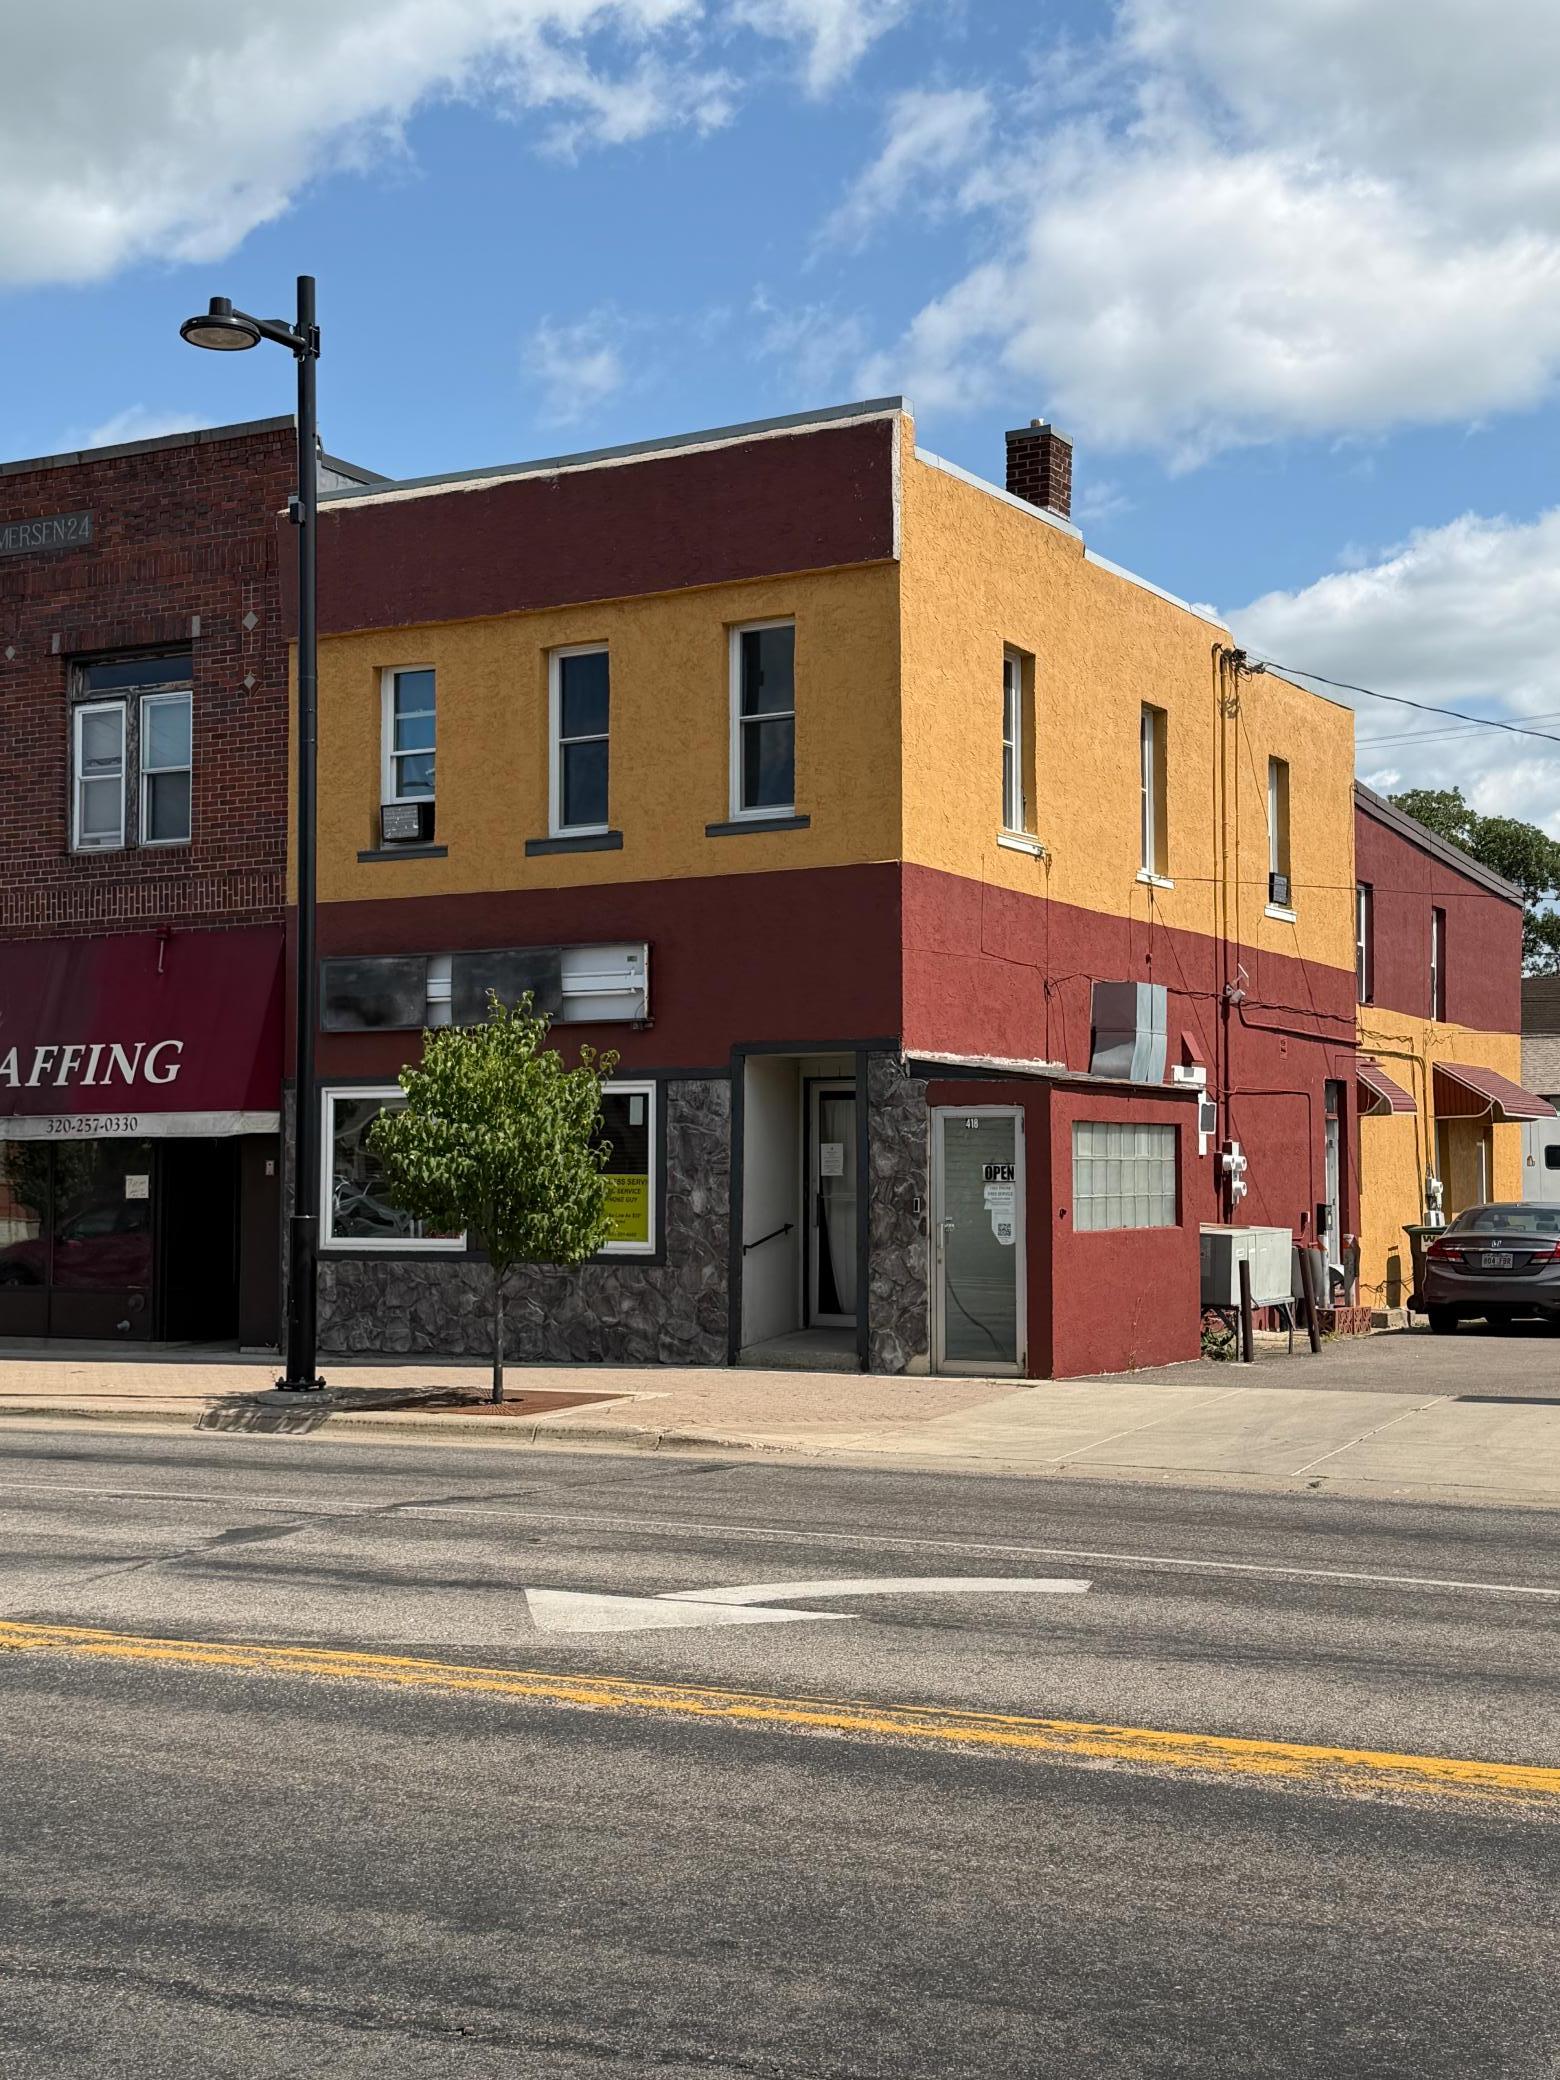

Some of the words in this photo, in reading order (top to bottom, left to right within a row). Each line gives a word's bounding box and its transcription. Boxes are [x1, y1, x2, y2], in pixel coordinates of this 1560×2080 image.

[0, 1040, 184, 1088] AFFING
[46, 1116, 138, 1133] 320-257-0330
[965, 1118, 979, 1129] 418
[984, 1165, 1015, 1181] OPEN
